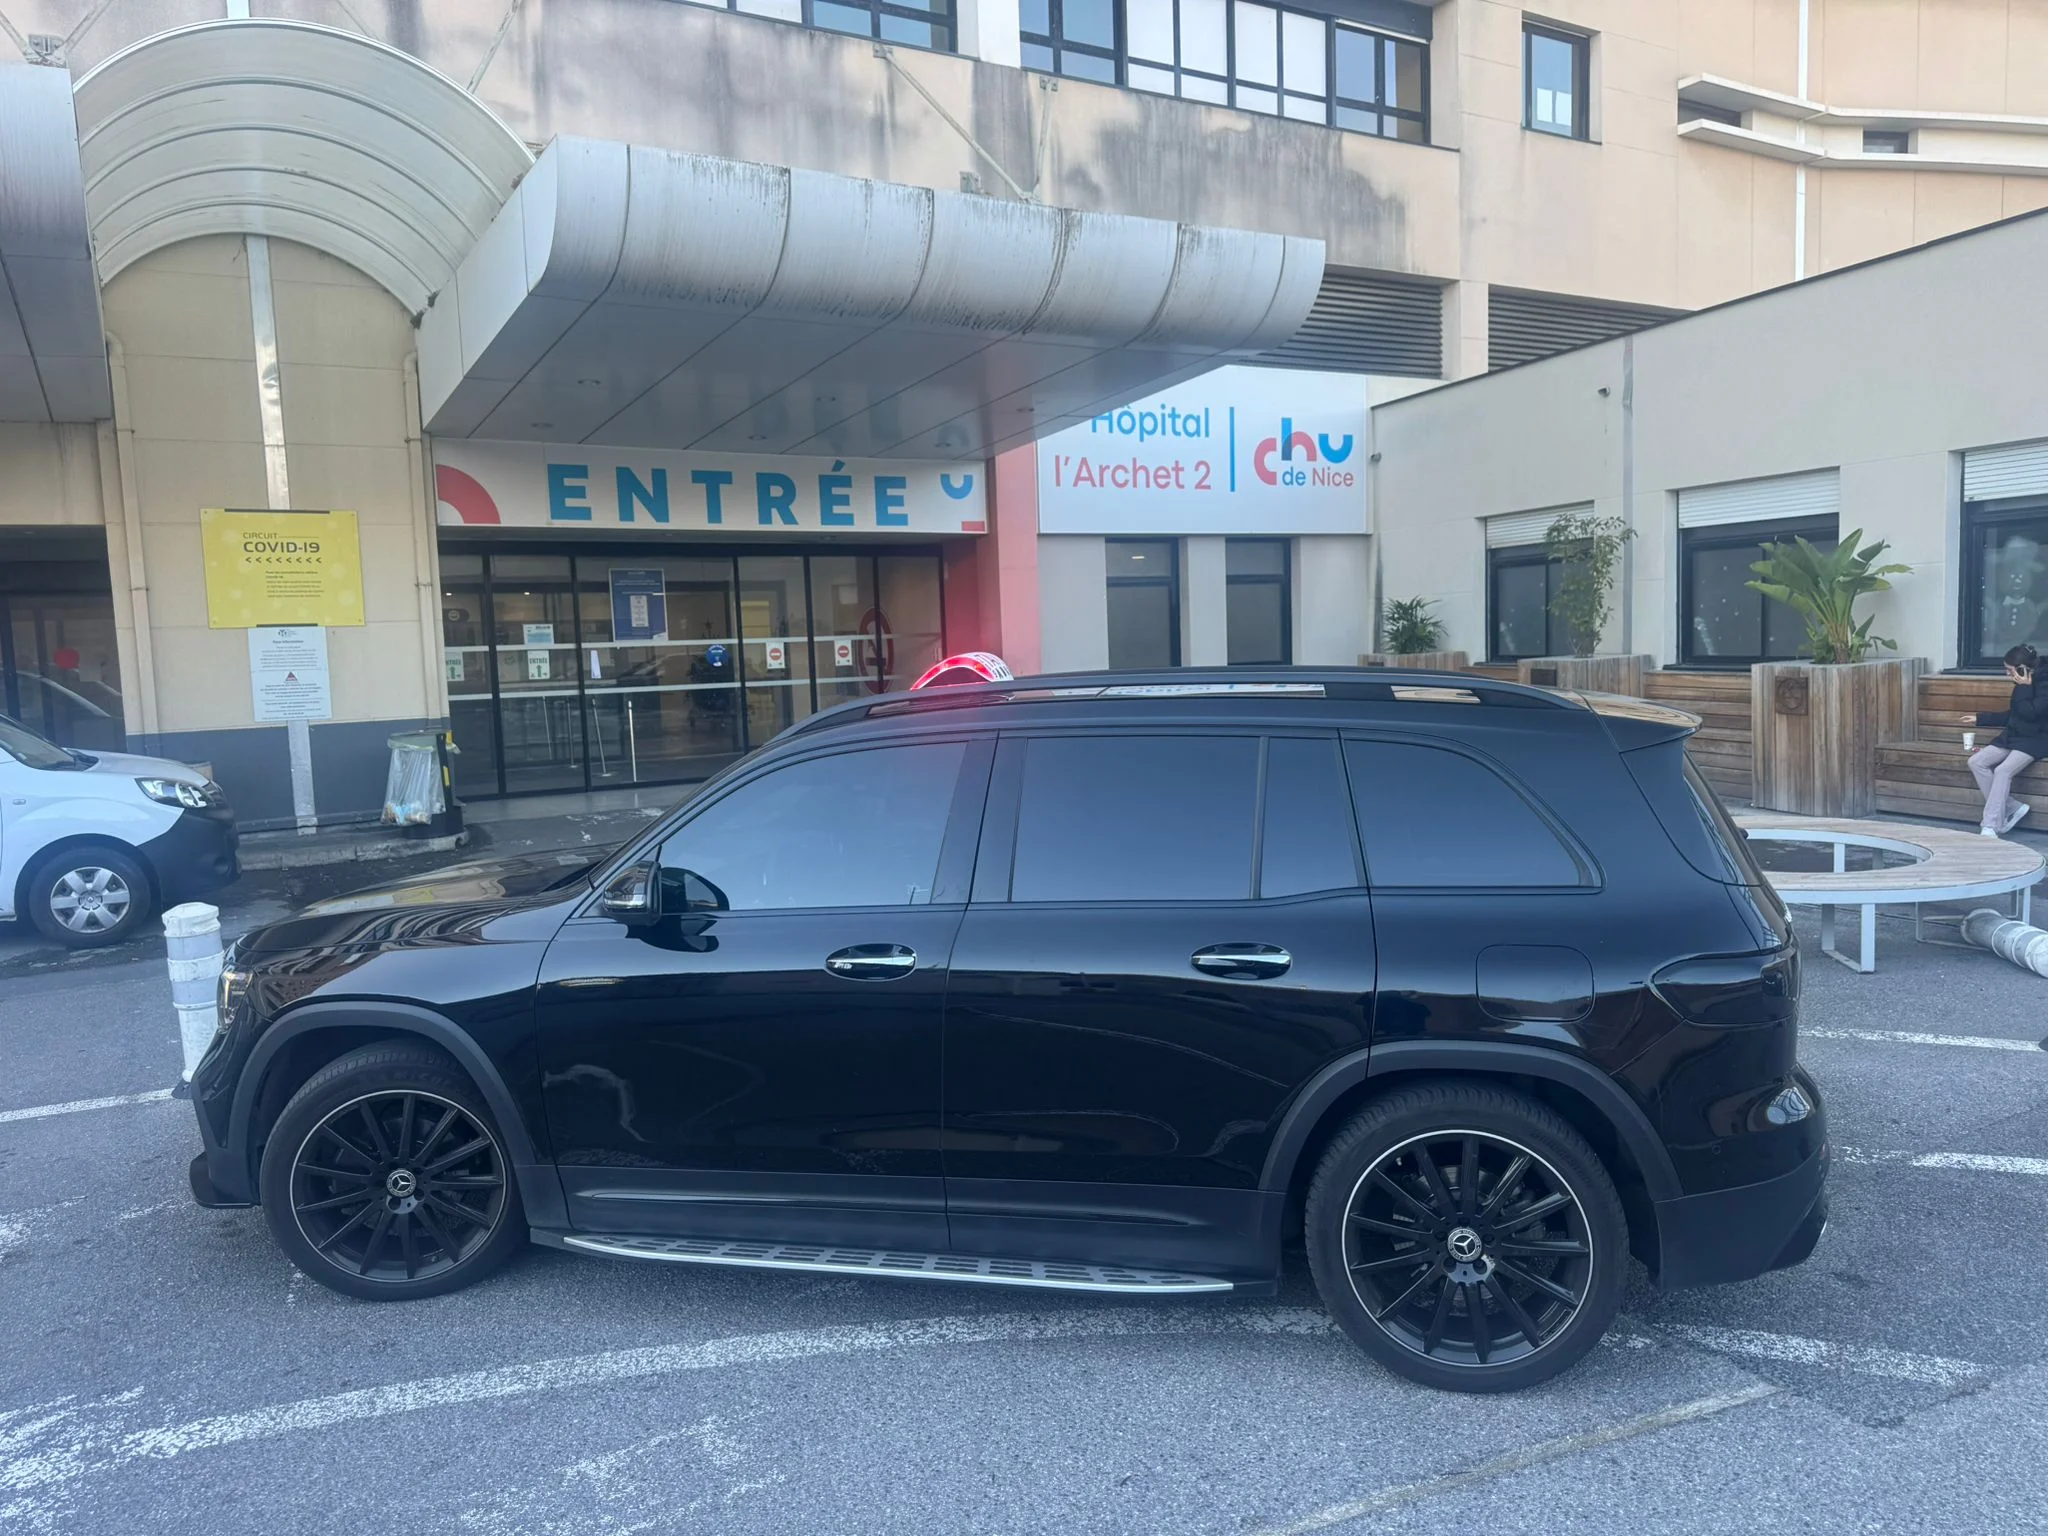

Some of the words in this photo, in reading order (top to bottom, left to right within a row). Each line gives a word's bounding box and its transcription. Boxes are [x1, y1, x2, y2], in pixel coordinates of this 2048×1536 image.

[1194, 460, 1212, 490] 2
[1282, 466, 1306, 486] de
[1312, 467, 1354, 487] Nice
[547, 459, 909, 526] ENTRÉE
[242, 531, 278, 540] CIRCUIT
[243, 541, 321, 553] COVID-19
